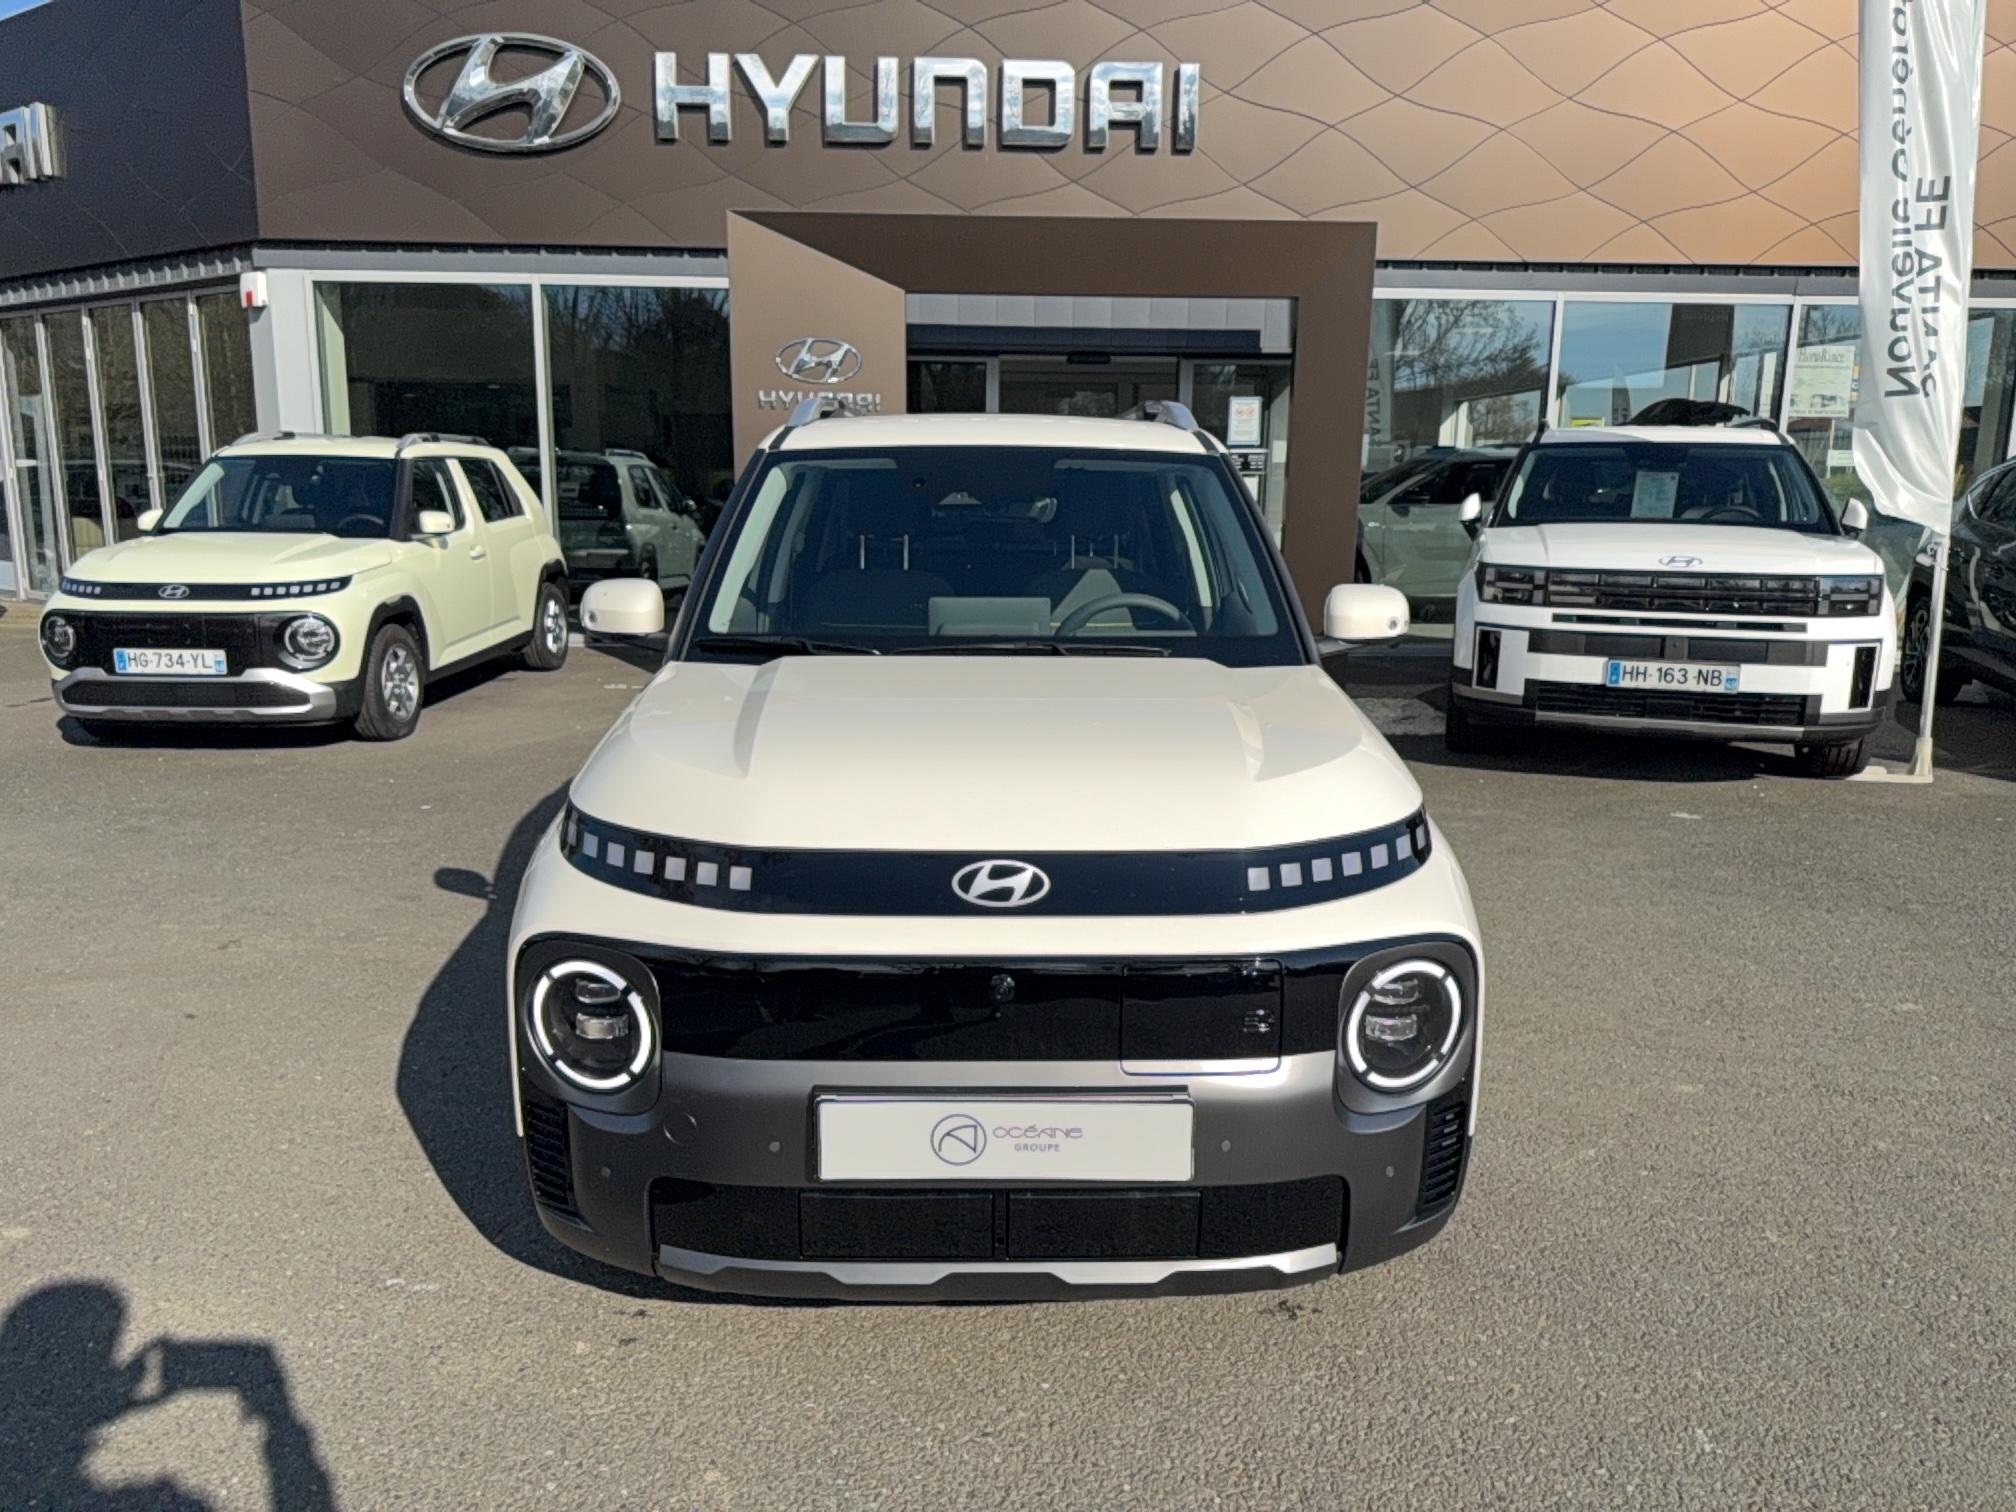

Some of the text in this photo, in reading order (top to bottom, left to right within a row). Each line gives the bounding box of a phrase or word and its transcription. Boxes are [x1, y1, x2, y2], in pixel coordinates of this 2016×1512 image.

[653, 50, 1201, 151] HYUNDAI
[127, 651, 213, 669] HG-734-YL
[992, 1123, 1084, 1139] OCÉANE
[1013, 1142, 1061, 1153] GROUPE
